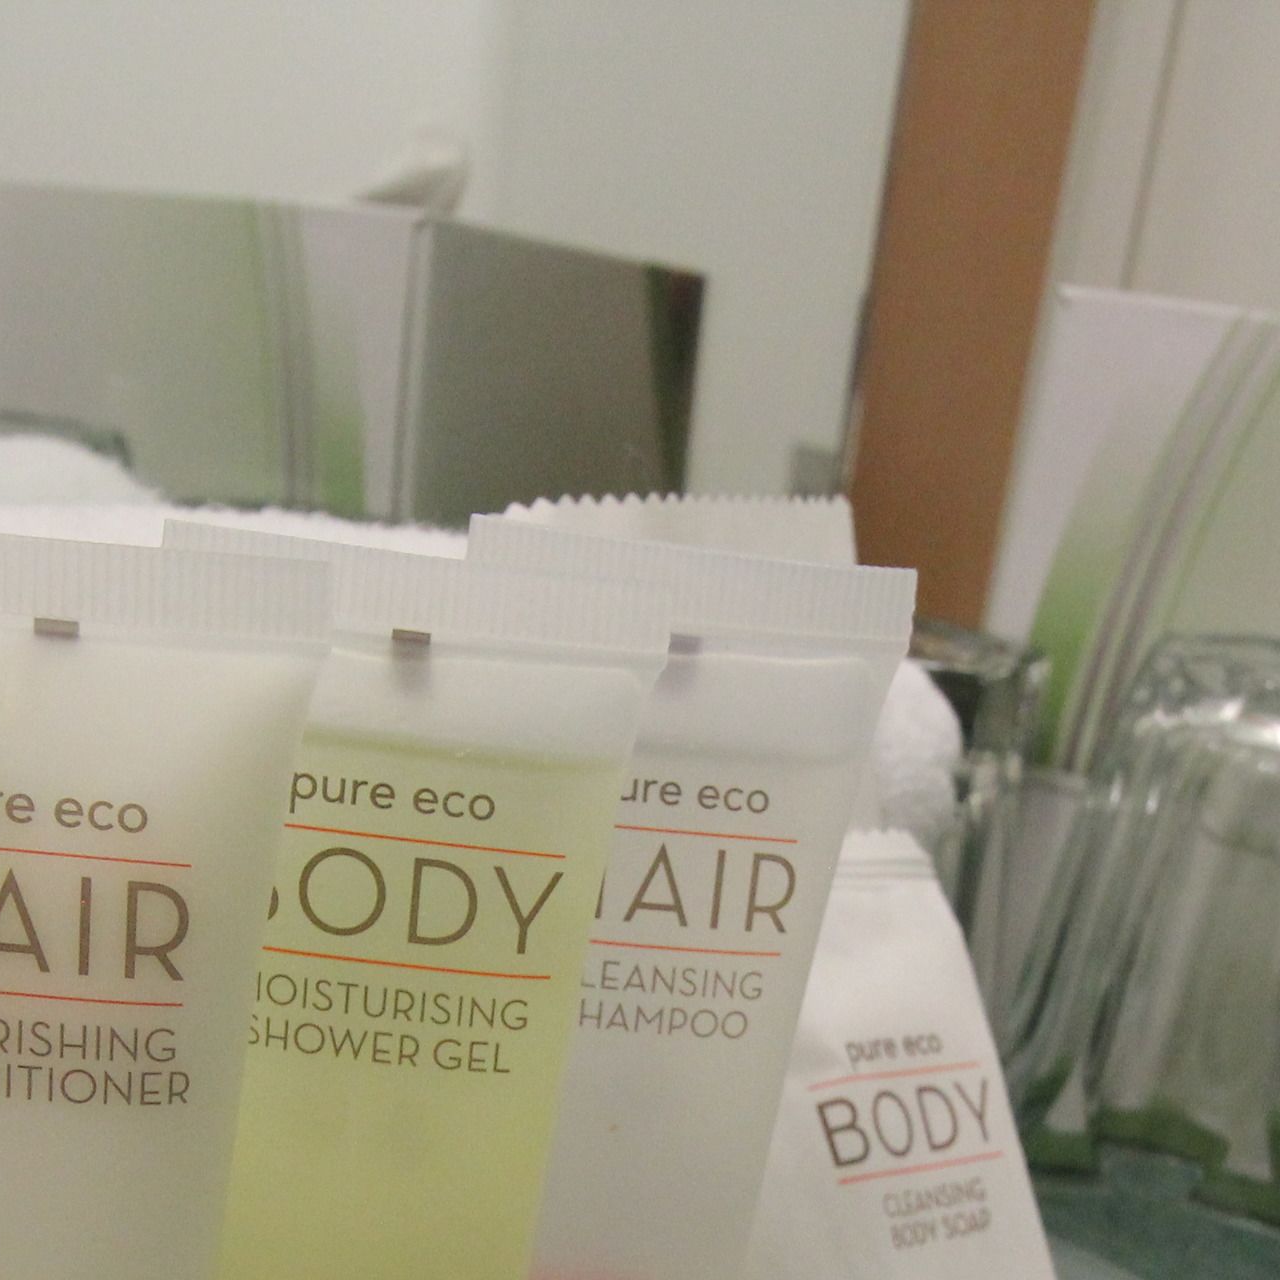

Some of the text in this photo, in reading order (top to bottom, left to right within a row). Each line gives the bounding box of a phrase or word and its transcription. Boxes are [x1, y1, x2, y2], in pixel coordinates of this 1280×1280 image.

[54, 797, 149, 834] eco
[289, 772, 496, 821] pure eco
[621, 778, 770, 814] ure eco
[268, 847, 565, 955] ODY
[256, 971, 529, 1032] OISTURISING
[578, 998, 748, 1039] HAMPOO
[433, 1038, 511, 1074] GEL
[844, 1033, 943, 1070] pure eco
[817, 1076, 990, 1169] BODY
